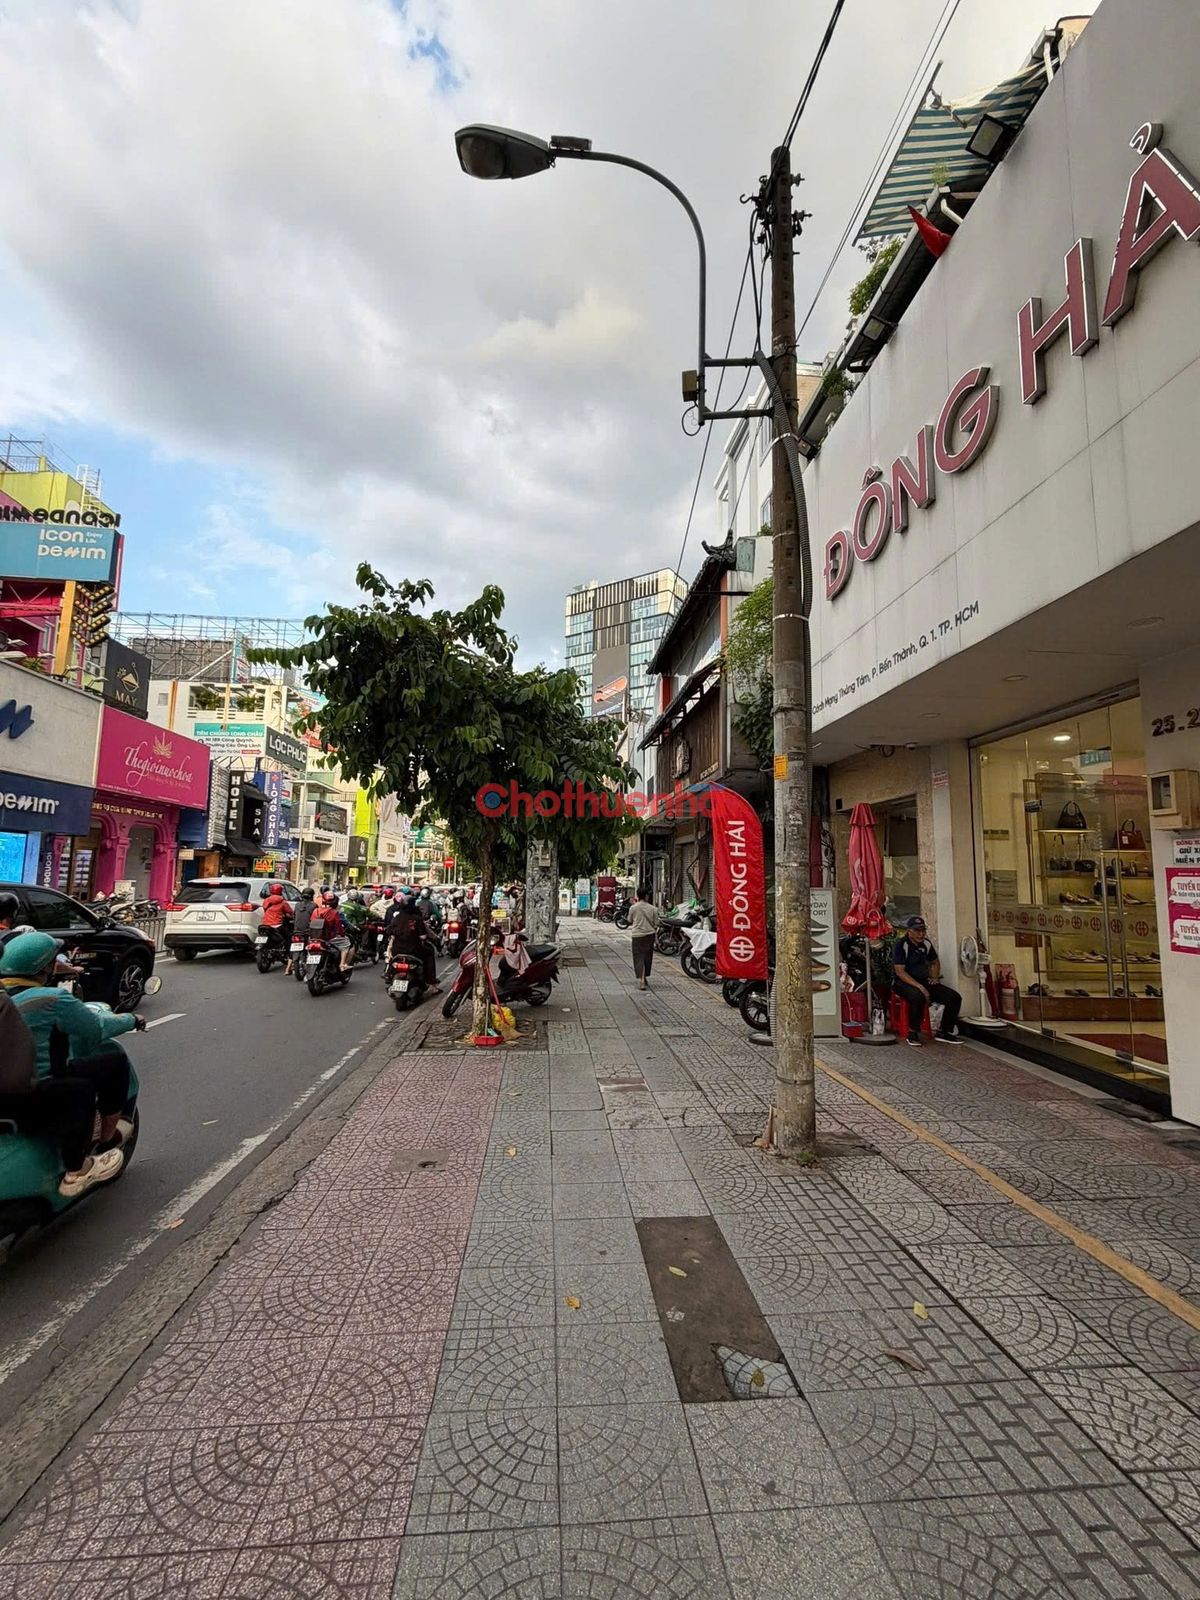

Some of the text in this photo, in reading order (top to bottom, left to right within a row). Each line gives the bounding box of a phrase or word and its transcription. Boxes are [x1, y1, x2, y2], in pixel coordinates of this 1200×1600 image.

[823, 366, 999, 601] ĐÔNG
[825, 695, 838, 708] Mạng
[839, 682, 856, 699] Tháng
[856, 672, 871, 688] Tám,
[872, 668, 878, 679] P.
[879, 657, 892, 674] Bến
[892, 642, 918, 665] Thành,
[919, 635, 929, 647] Q.
[938, 619, 953, 636] TP.
[955, 600, 979, 627] HCM
[1152, 708, 1200, 737] 25.2
[269, 735, 307, 764] LỘC PHÚC
[1082, 751, 1105, 764] EXIT
[229, 776, 241, 830] HOTEL
[268, 783, 278, 845] LONG CHÂU
[253, 808, 261, 835] SPA
[1179, 846, 1192, 854] GIỮ
[724, 820, 751, 931] ĐÔNG HẢI
[1177, 879, 1196, 891] TUYỂN
[1180, 923, 1199, 935] TUYỂN
